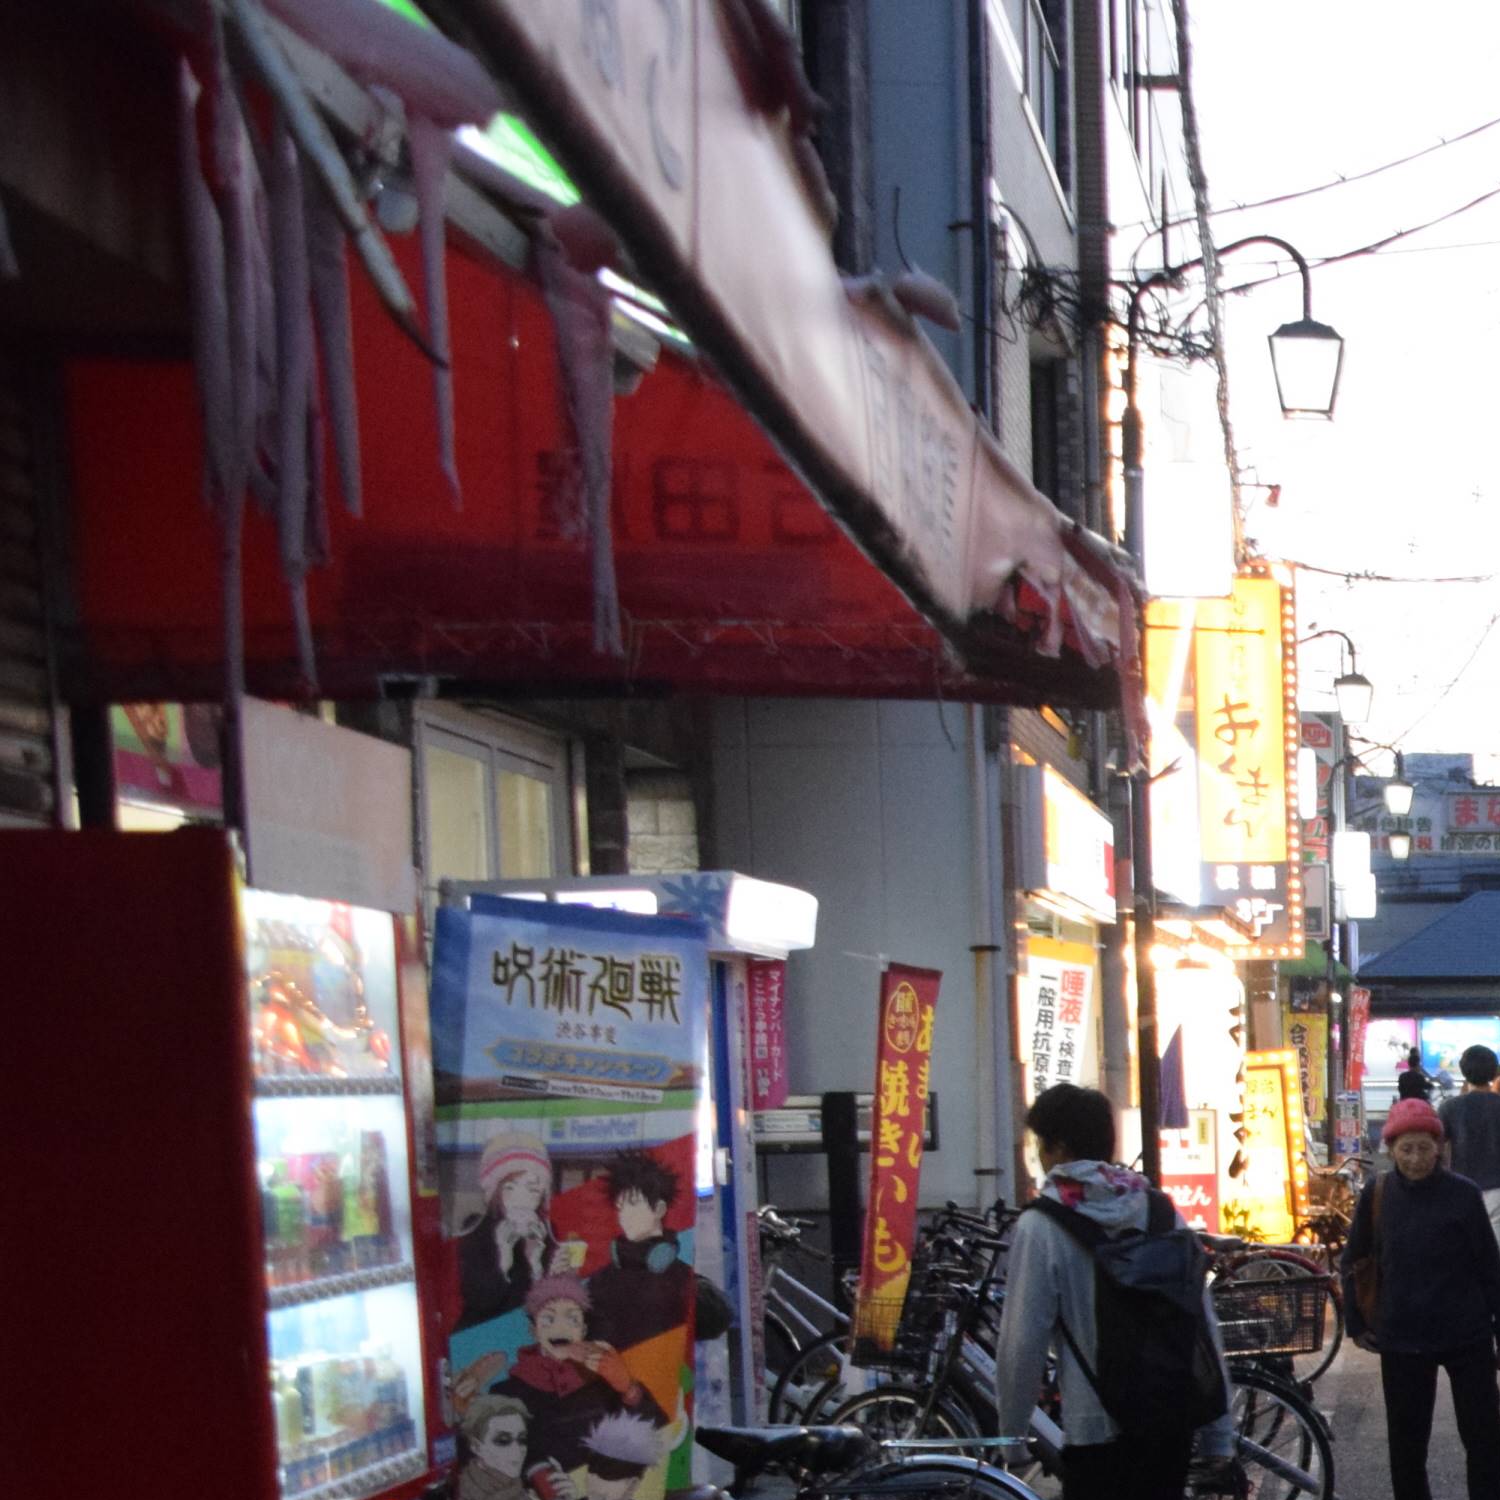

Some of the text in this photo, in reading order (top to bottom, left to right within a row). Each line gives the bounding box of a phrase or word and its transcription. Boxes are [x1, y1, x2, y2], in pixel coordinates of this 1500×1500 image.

[492, 941, 681, 1025] 呪術廻戦
[1055, 969, 1087, 1087] 唾液で検査
